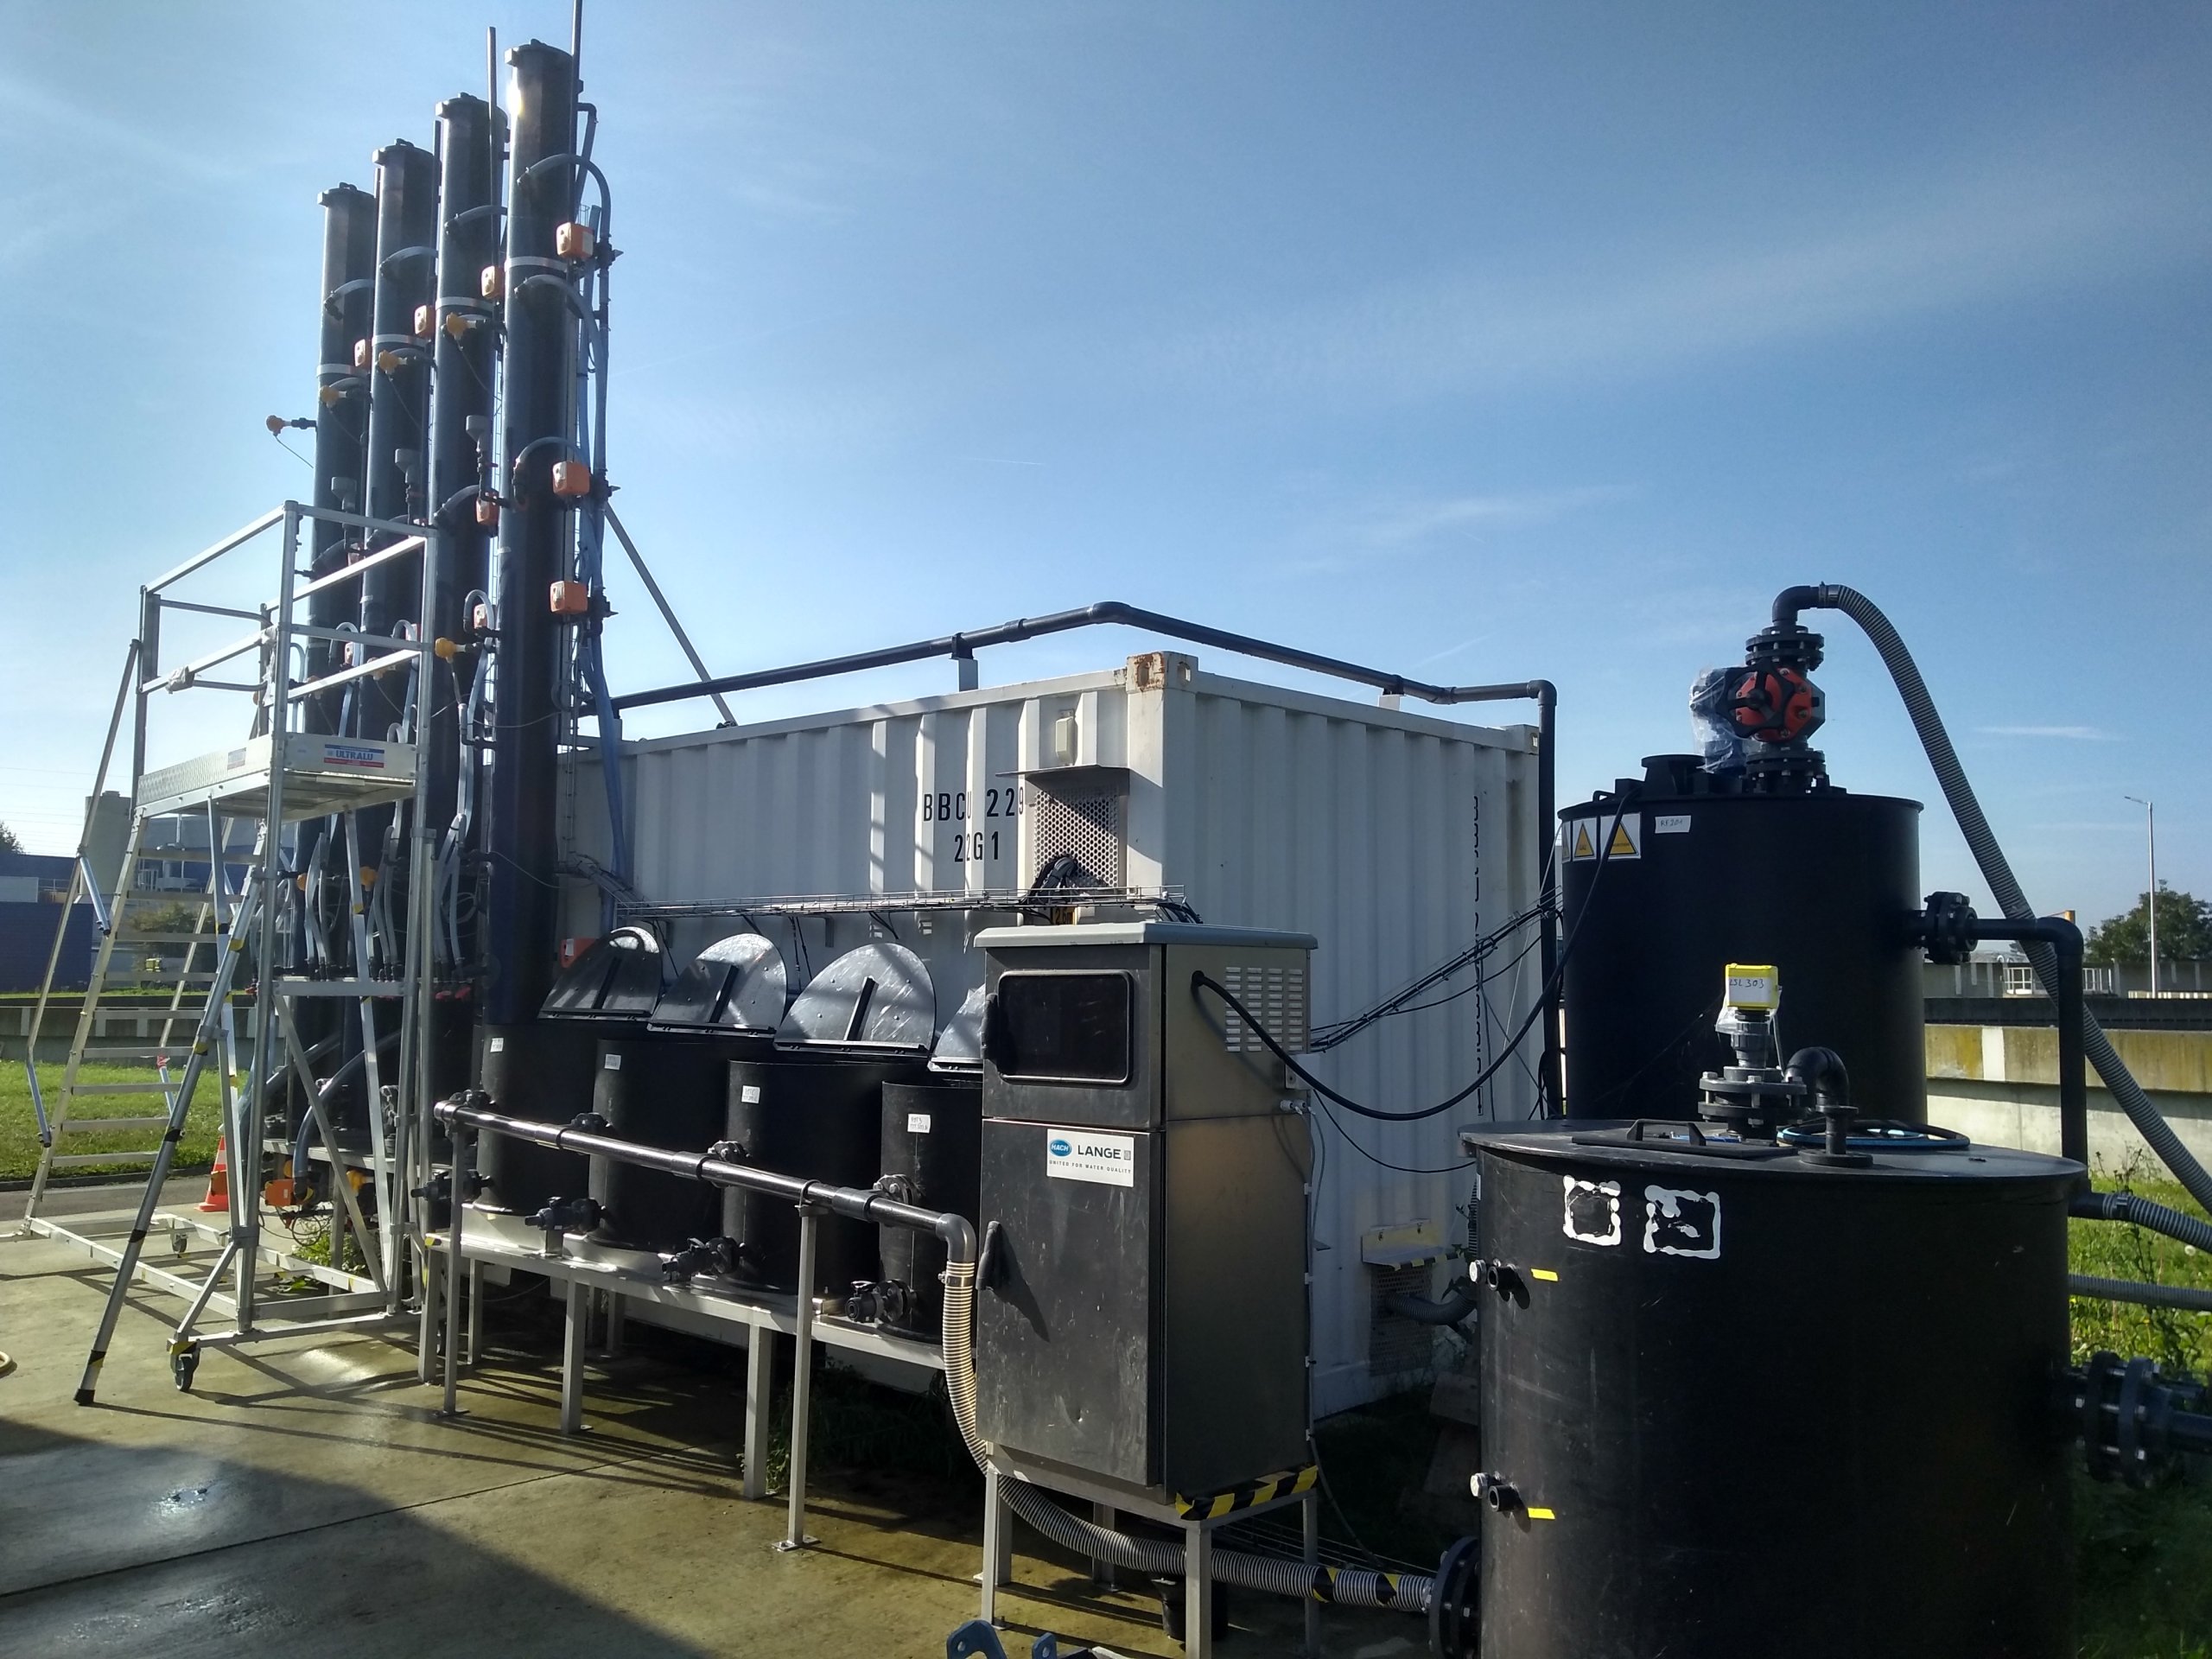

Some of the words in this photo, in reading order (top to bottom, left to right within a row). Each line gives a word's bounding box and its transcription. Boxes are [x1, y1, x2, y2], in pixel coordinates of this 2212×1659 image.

[335, 750, 373, 760] ULTRALU
[923, 791, 972, 822] BBCU
[953, 830, 999, 862] 22G1
[1077, 1145, 1121, 1160] LANGE
